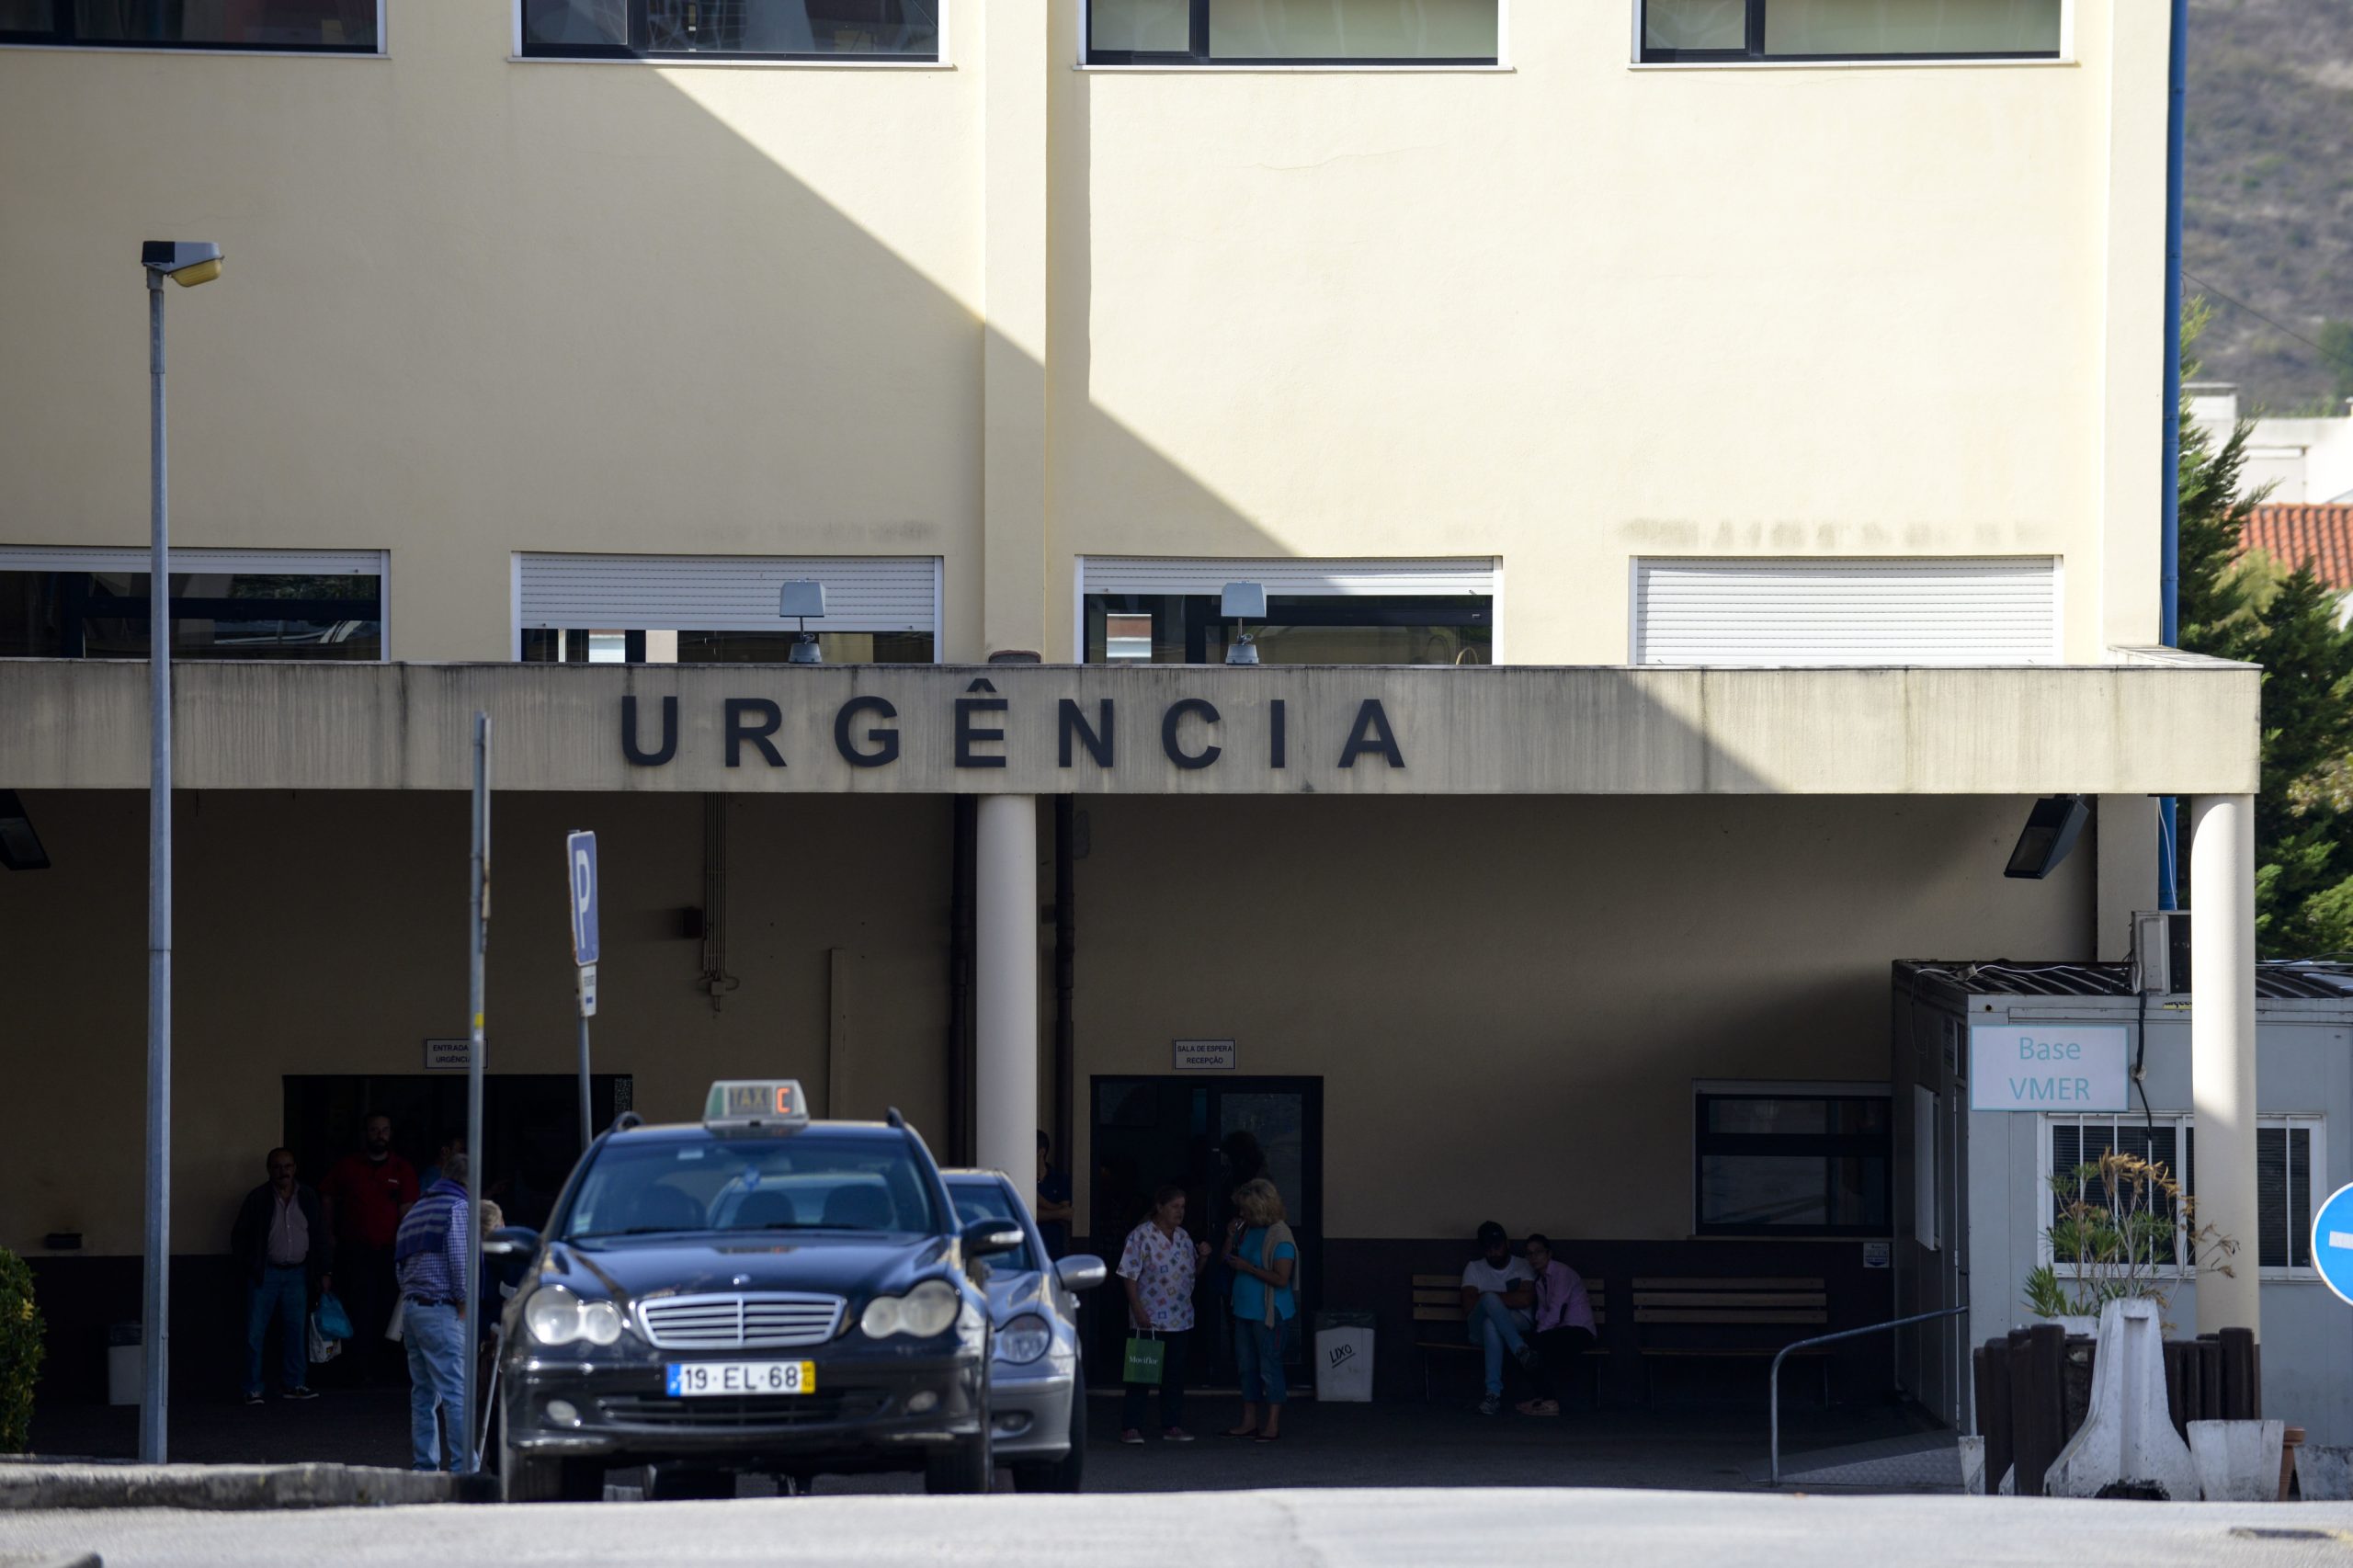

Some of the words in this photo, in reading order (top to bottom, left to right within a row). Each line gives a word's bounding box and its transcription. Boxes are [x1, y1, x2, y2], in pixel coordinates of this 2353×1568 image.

[621, 678, 1406, 769] URGÊNCIA
[575, 849, 591, 949] P
[436, 1055, 471, 1063] URGÊNCI
[1187, 1055, 1223, 1064] RECEPÇÃO
[2019, 1037, 2081, 1060] Base
[777, 1087, 790, 1113] C
[2009, 1077, 2090, 1100] VMER
[1329, 1344, 1352, 1363] LIXO
